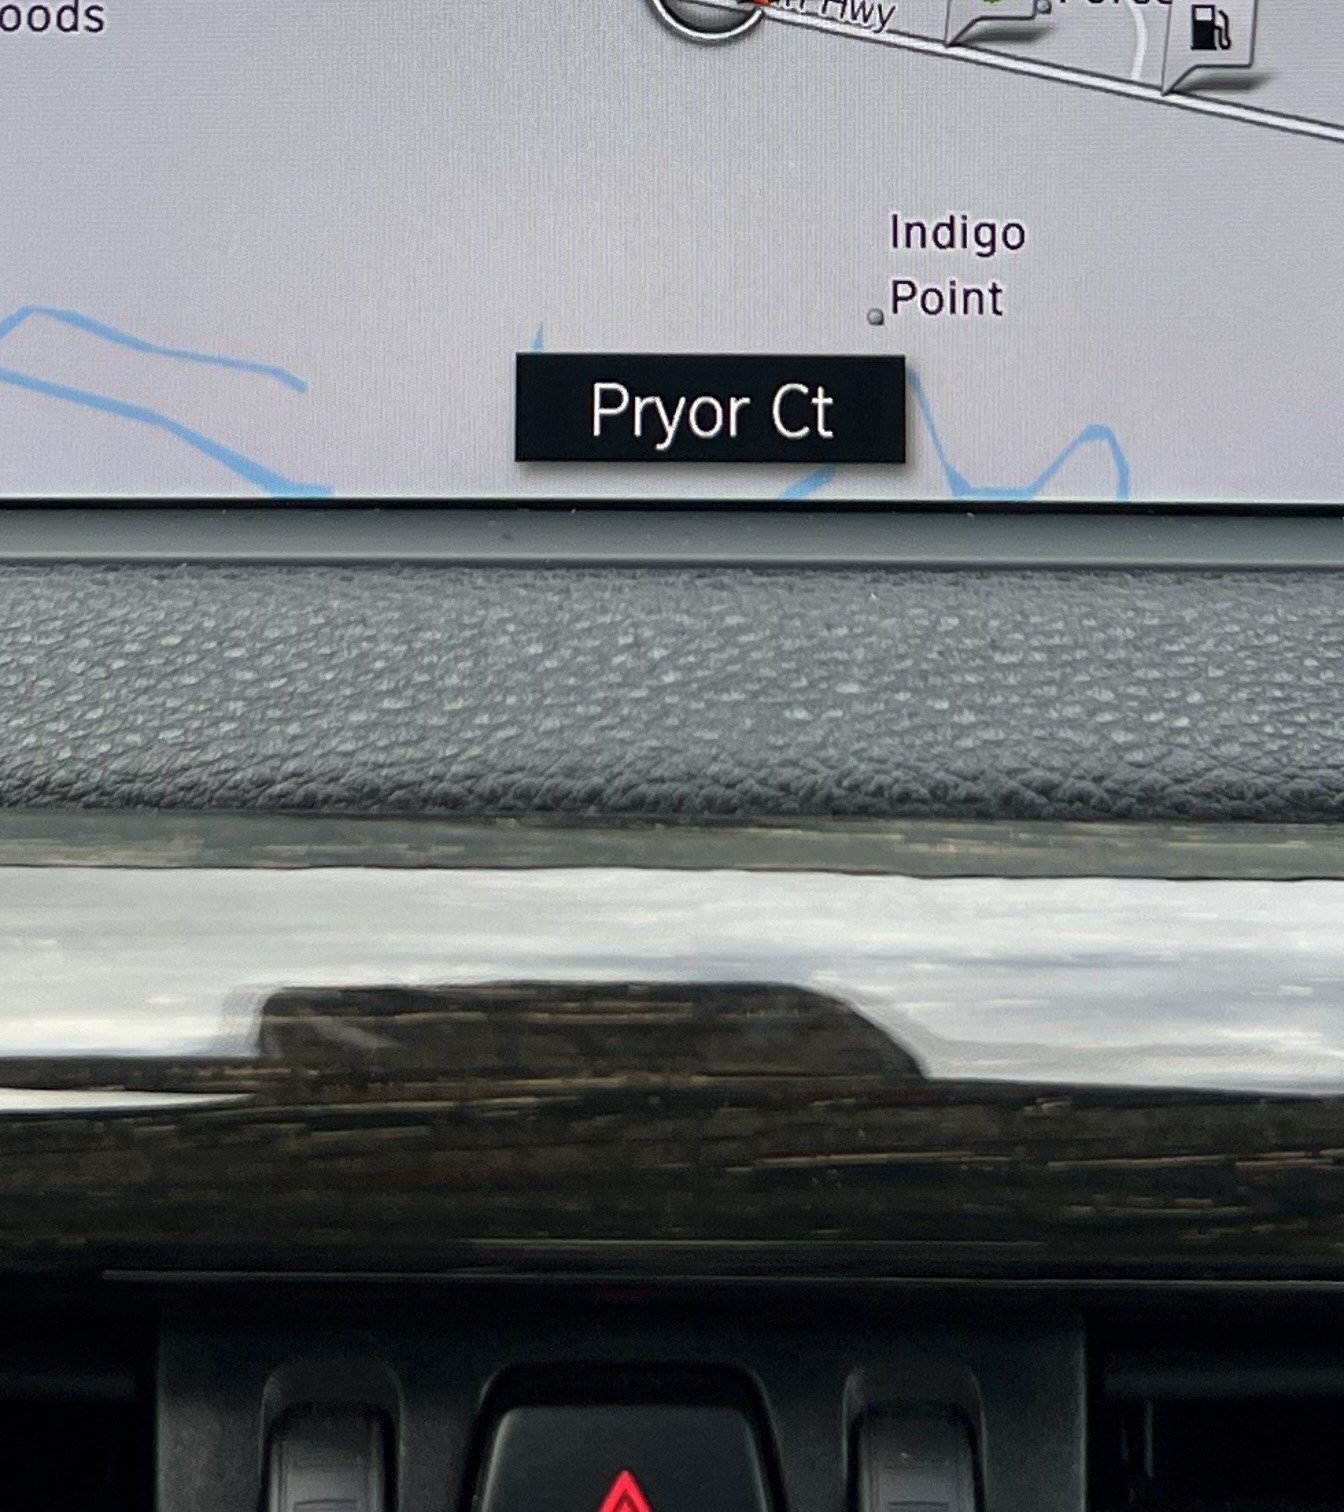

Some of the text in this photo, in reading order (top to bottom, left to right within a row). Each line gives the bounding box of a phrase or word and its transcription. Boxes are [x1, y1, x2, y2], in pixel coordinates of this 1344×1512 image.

[890, 214, 1027, 258] Indigo
[891, 280, 1004, 317] Point
[592, 382, 834, 452] Pryor Ct
